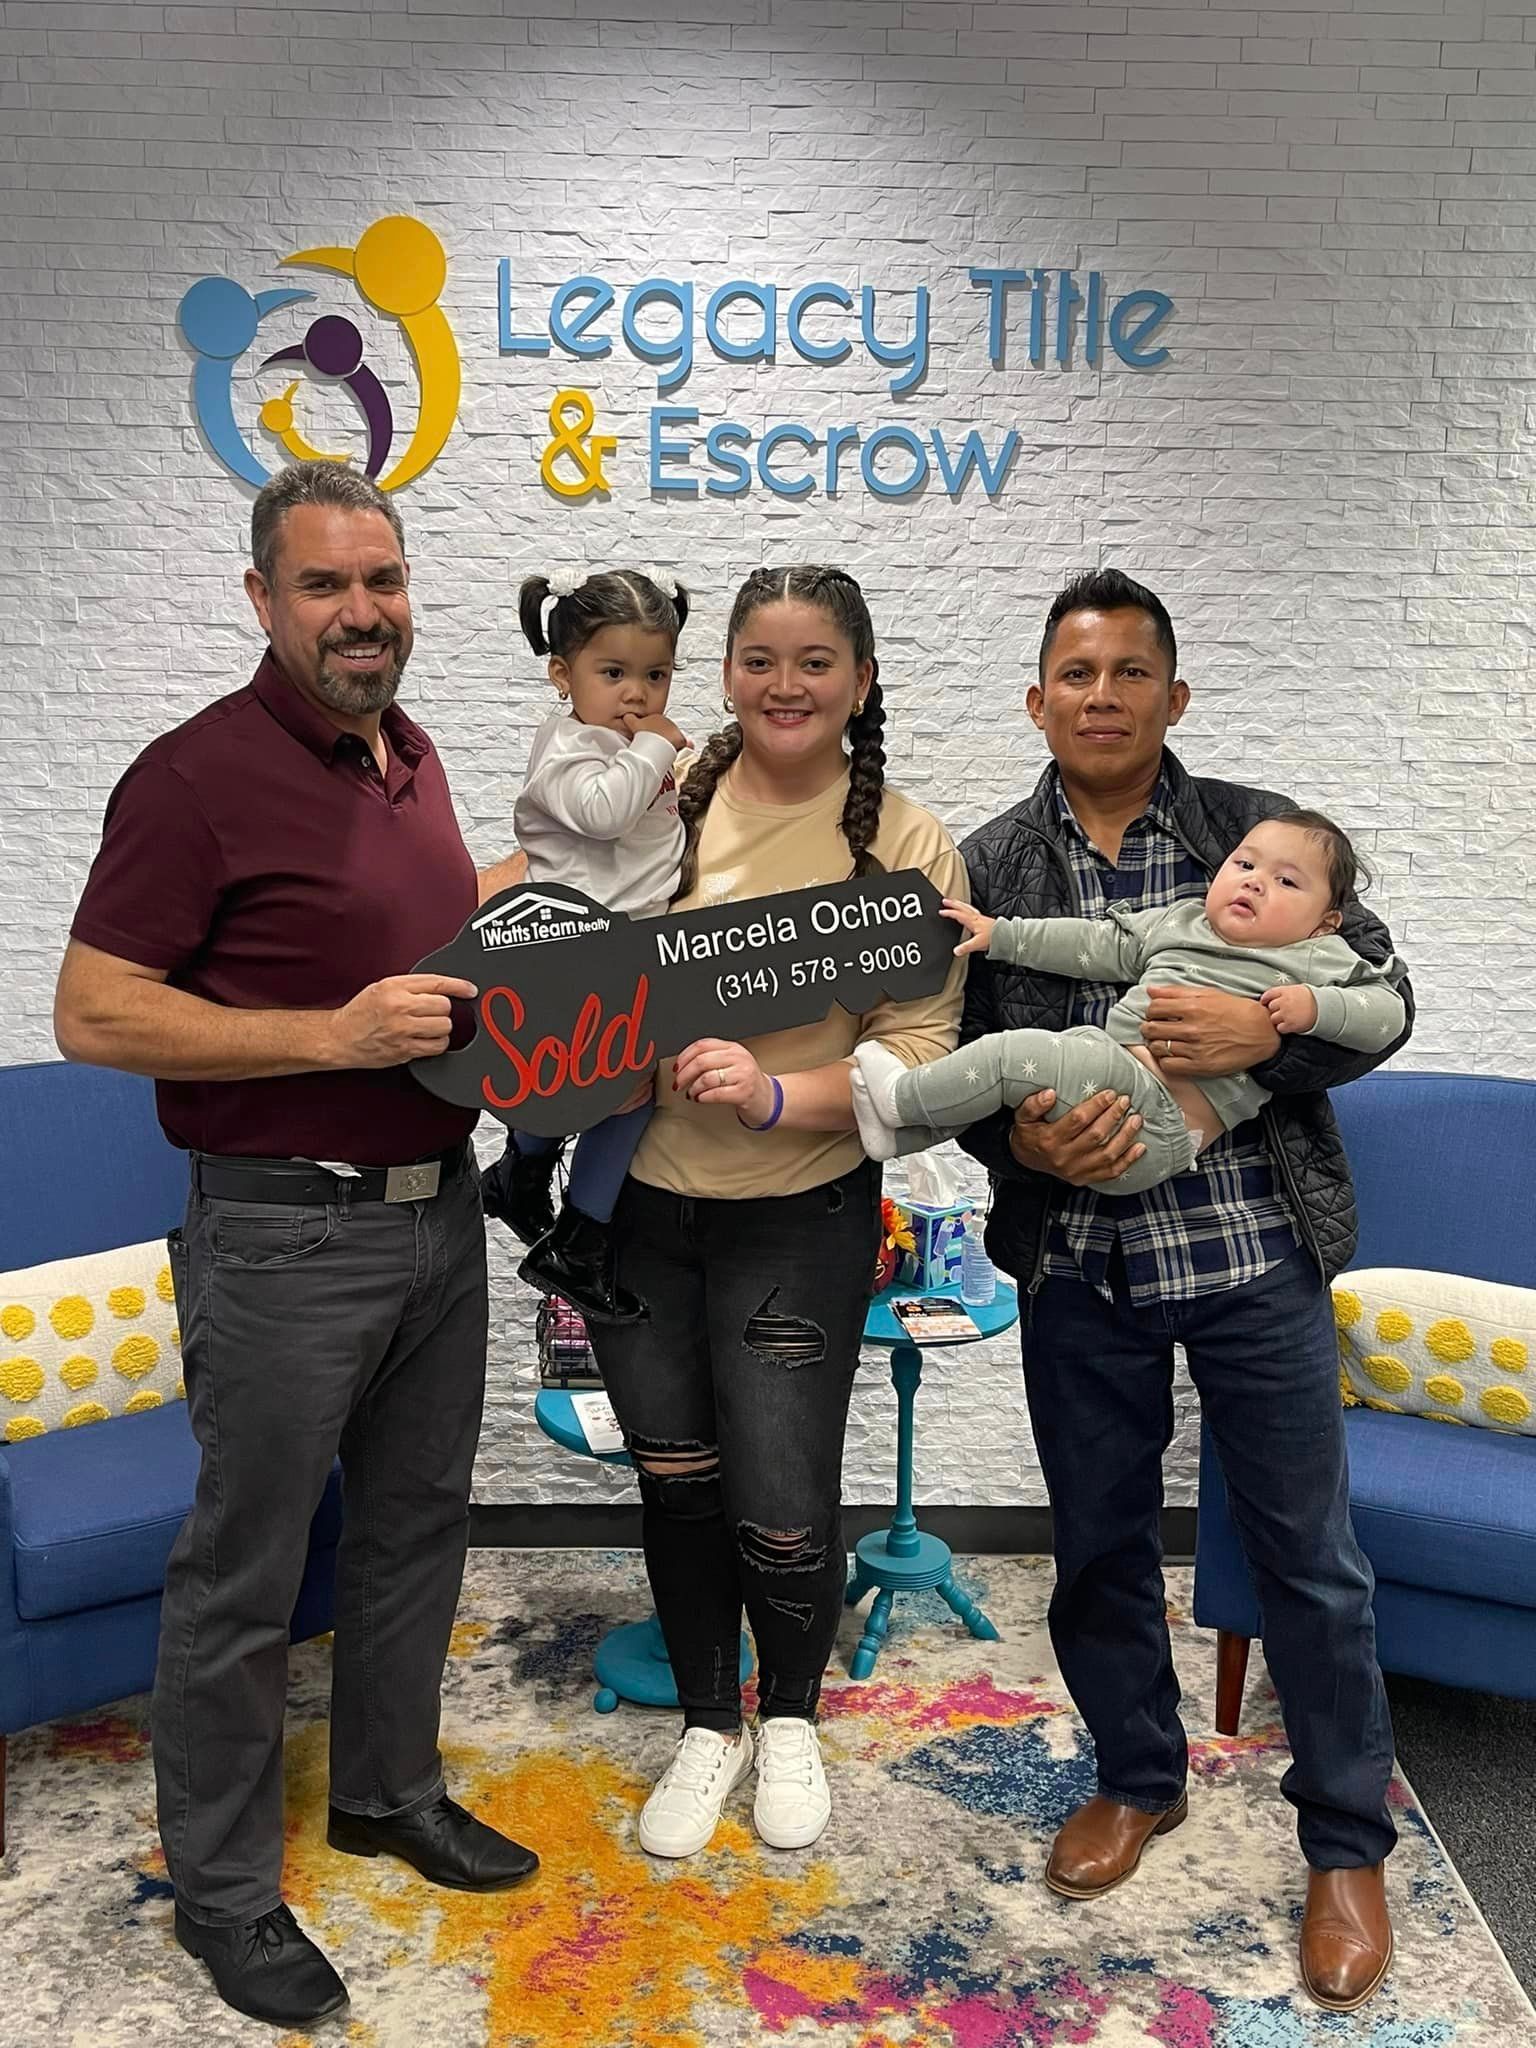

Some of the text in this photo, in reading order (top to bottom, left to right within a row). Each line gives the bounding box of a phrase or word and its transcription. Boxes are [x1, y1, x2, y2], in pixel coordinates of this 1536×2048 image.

[500, 259, 1176, 390] Legacy Title
[541, 390, 1020, 497] & Escrow
[485, 918, 610, 946] Watts Team Realty
[656, 889, 923, 967] Marcela Ochoa
[715, 966, 779, 1006] (314)
[791, 959, 838, 987] 578
[860, 942, 922, 974] 9006
[480, 973, 655, 1109] Sold
